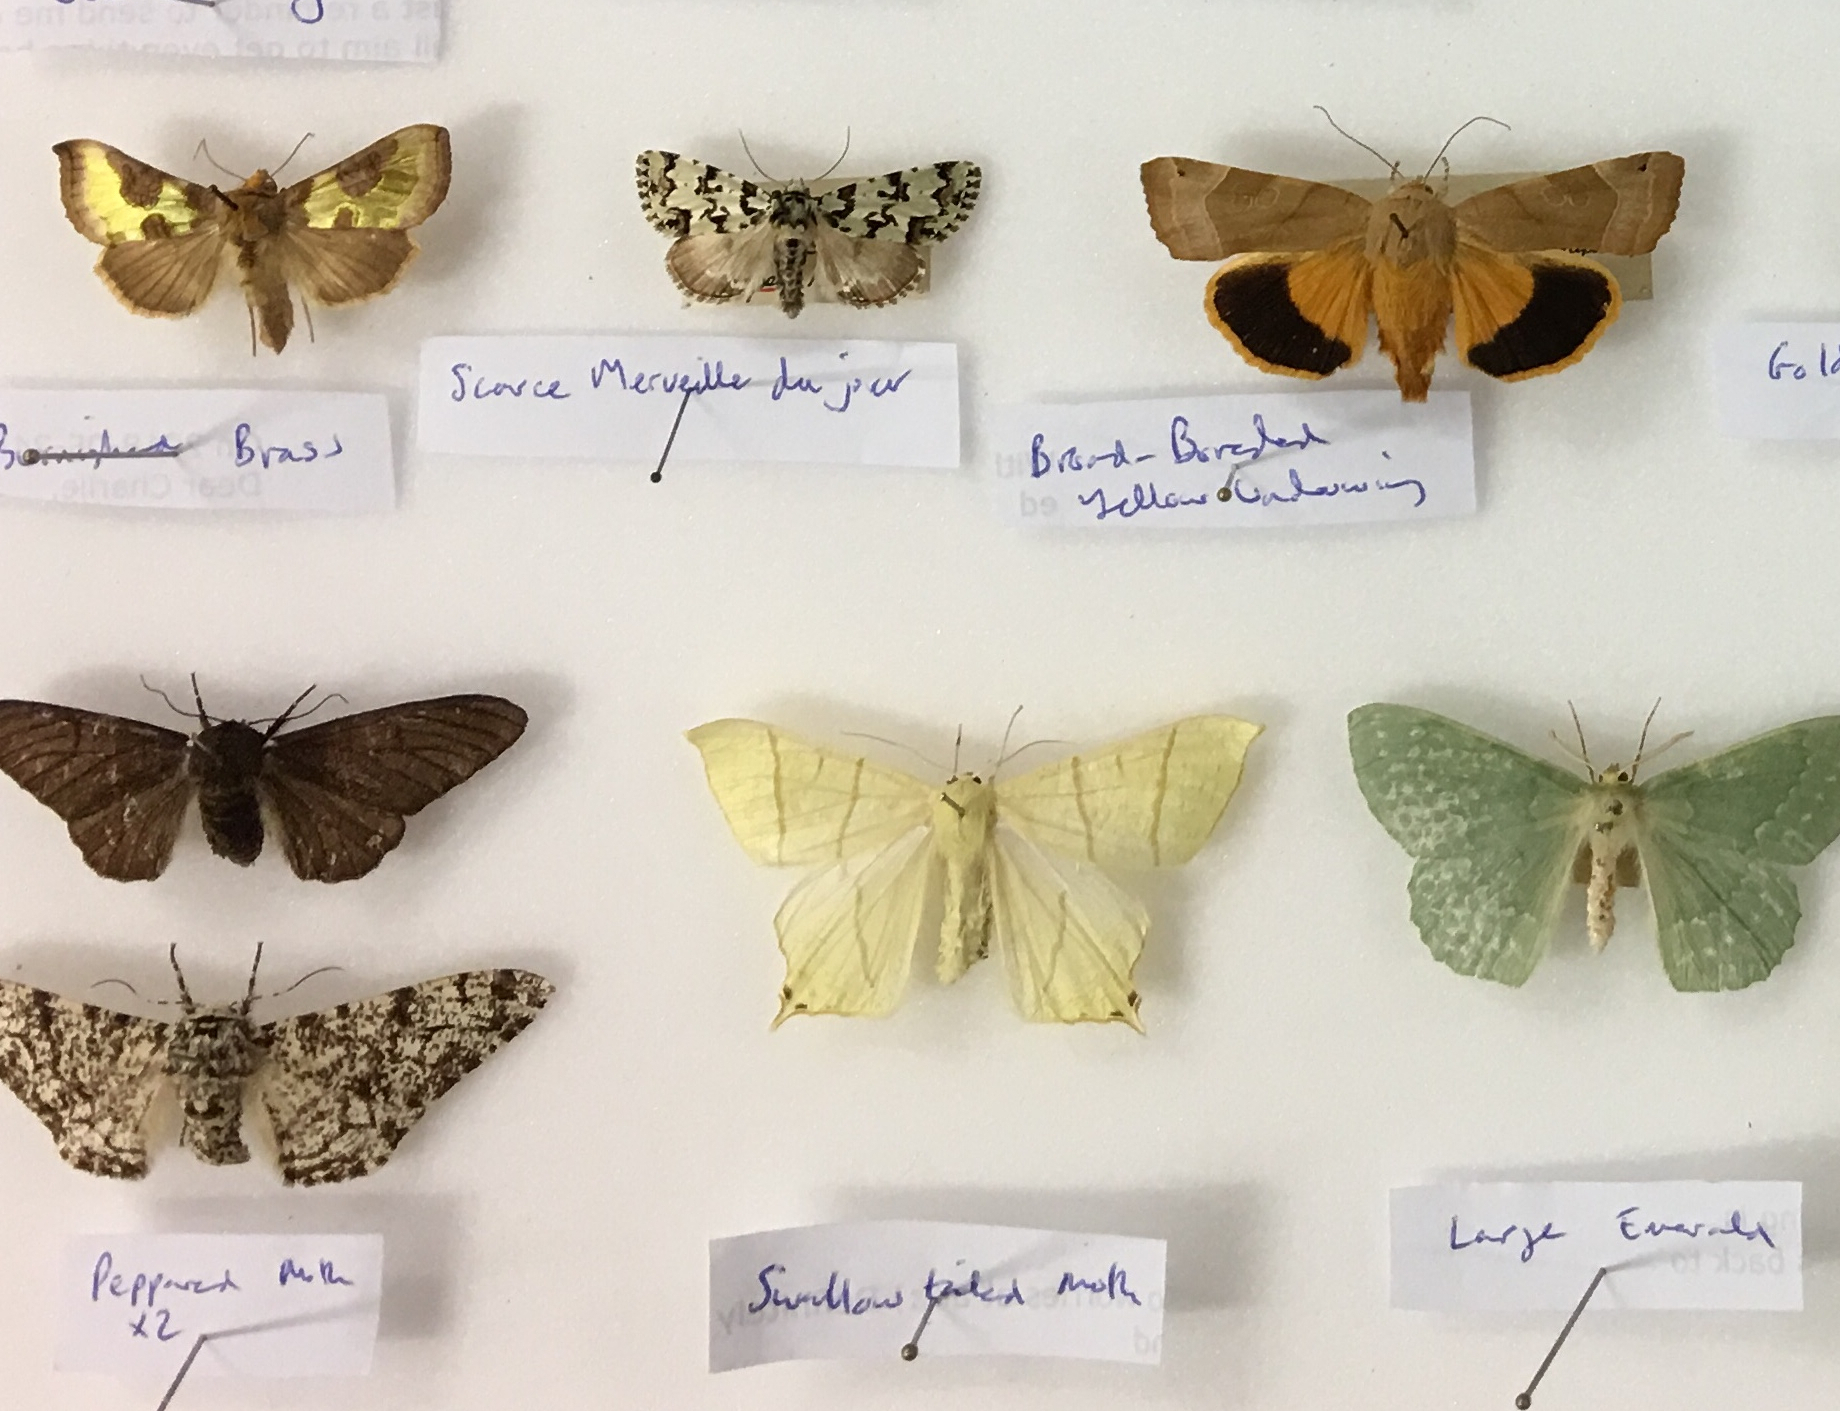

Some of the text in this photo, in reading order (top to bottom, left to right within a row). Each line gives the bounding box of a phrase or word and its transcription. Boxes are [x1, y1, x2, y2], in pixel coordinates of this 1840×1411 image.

[233, 422, 344, 470] Brass
[1449, 1215, 1567, 1263] Large
[1616, 1206, 1777, 1249] Emerald
[747, 1263, 904, 1316] Swallow
